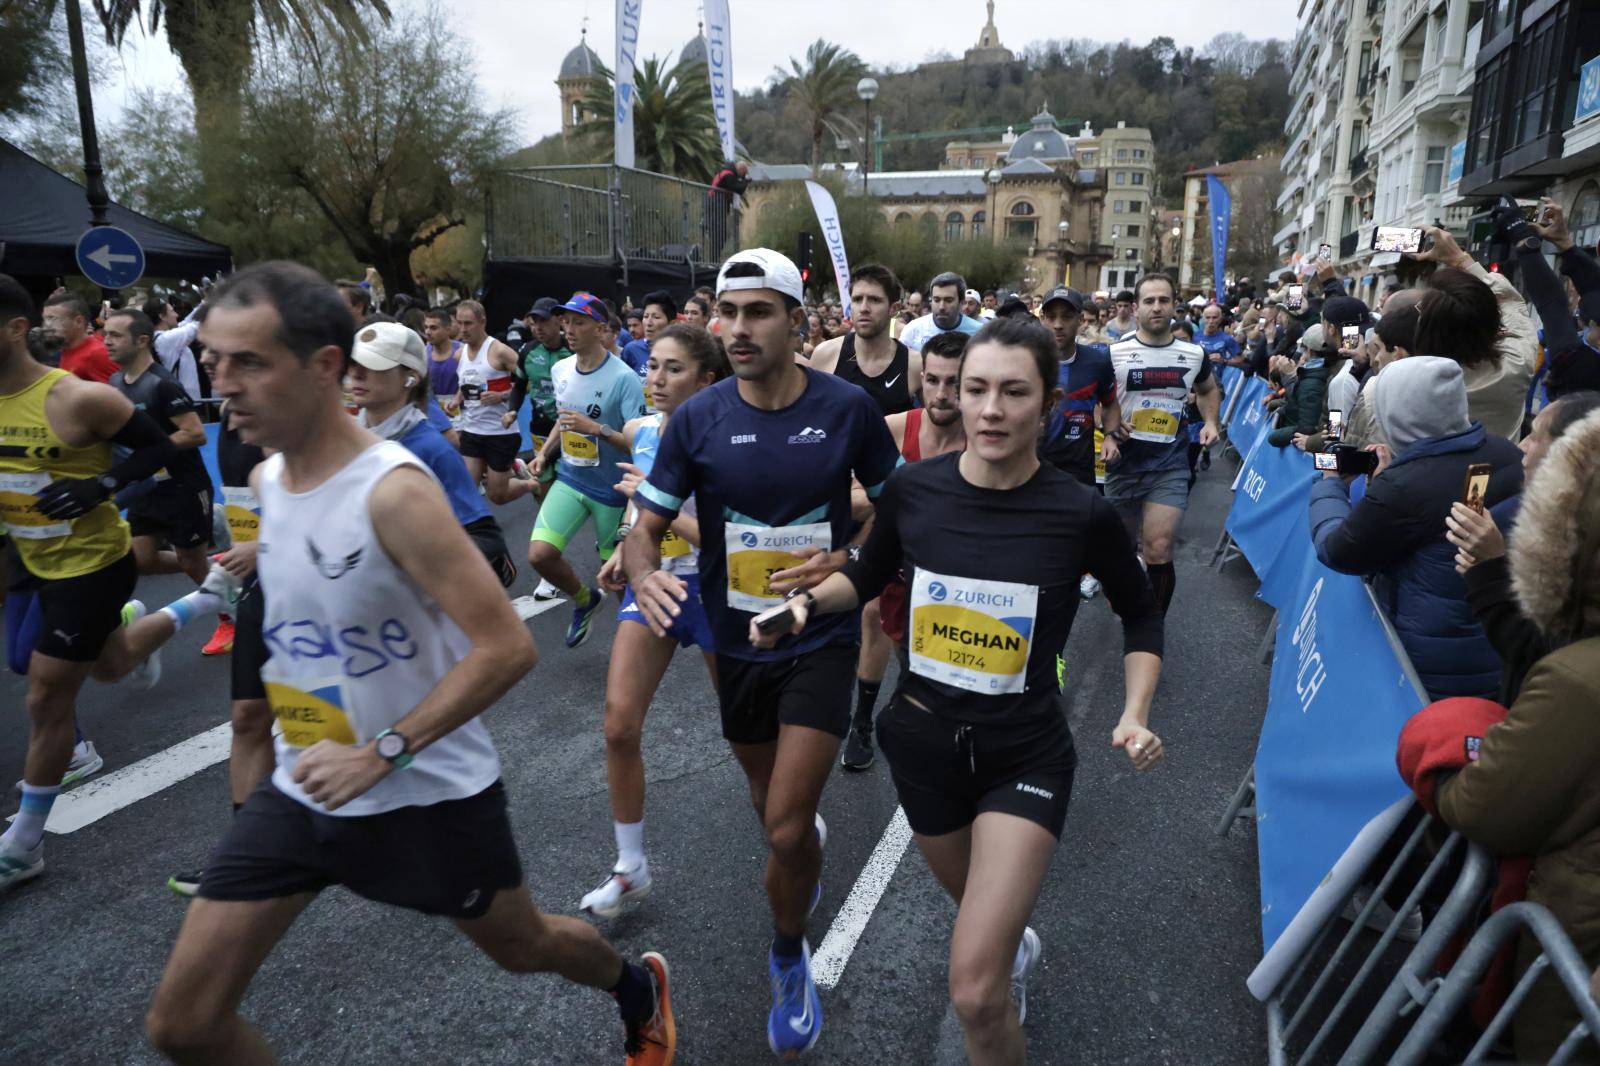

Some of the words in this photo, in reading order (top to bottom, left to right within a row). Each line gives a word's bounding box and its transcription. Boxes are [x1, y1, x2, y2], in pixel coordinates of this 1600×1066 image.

[731, 434, 757, 444] GOBIK
[228, 518, 259, 529] DAVID
[764, 535, 813, 547] ZURICH
[954, 590, 1014, 607] ZURICH
[932, 622, 1020, 651] MEGHAN
[948, 649, 986, 669] 12174
[1023, 784, 1054, 799] BANDIT
